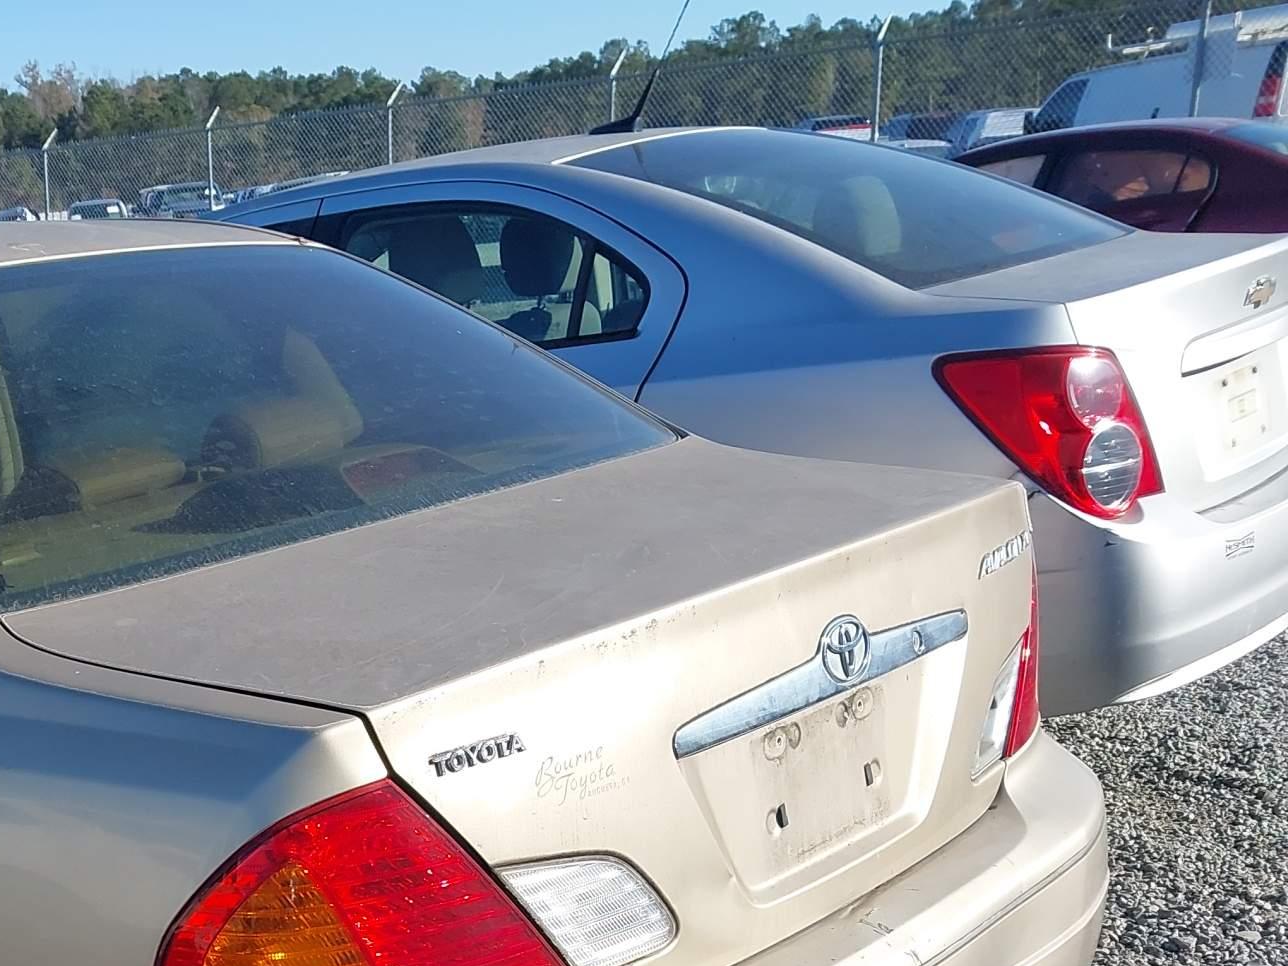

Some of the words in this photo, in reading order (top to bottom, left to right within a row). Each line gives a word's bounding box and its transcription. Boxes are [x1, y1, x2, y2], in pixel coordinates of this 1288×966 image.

[427, 732, 527, 778] TOYOTA
[535, 745, 603, 798] Bourne
[554, 760, 617, 806] Toyota
